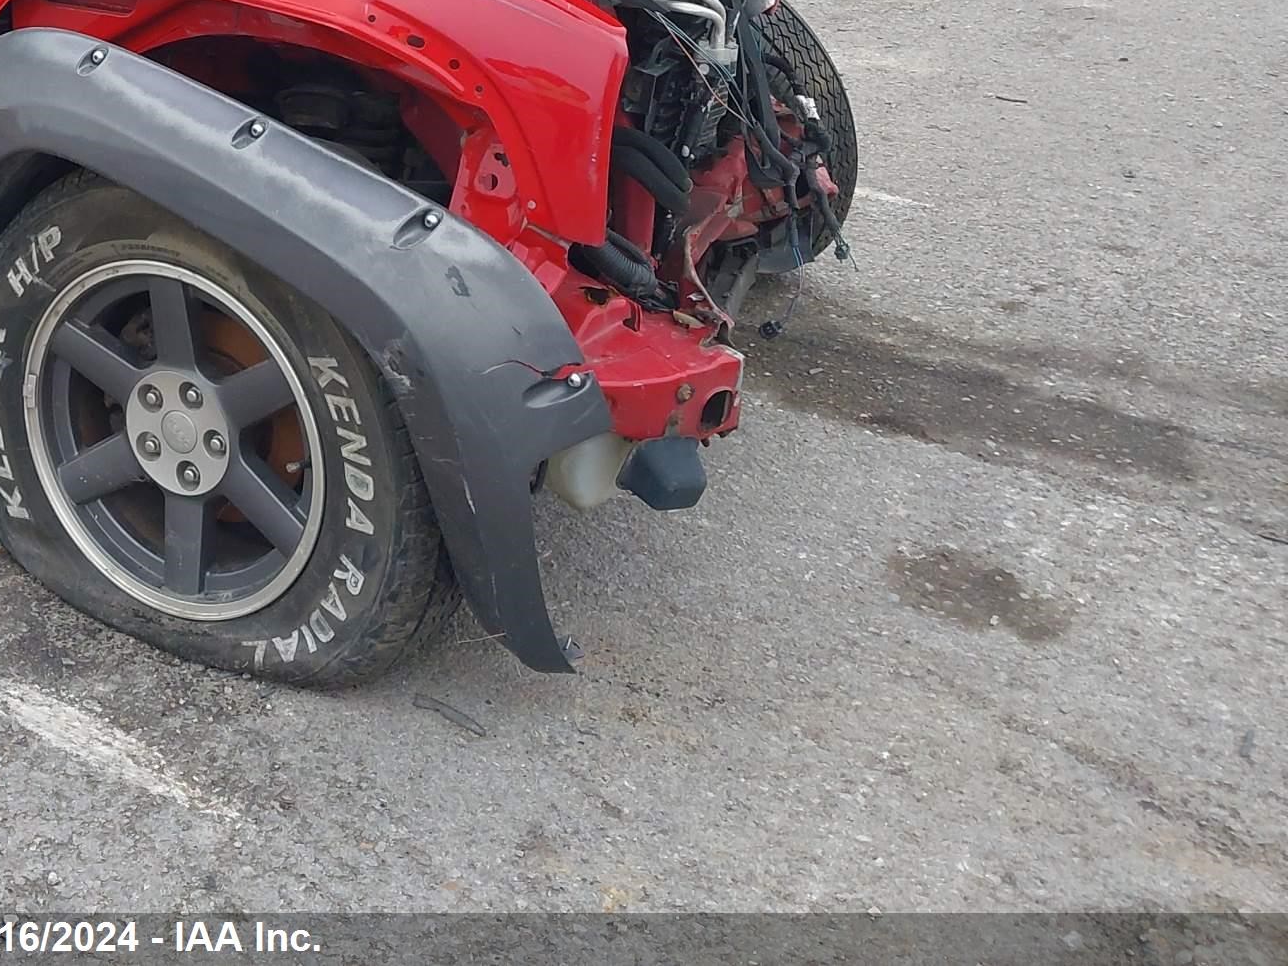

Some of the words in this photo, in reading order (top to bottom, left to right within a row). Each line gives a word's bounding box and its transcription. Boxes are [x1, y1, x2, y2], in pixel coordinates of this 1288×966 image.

[7, 225, 62, 297] H/P
[307, 354, 375, 535] KENDA
[242, 554, 367, 669] RADIAL
